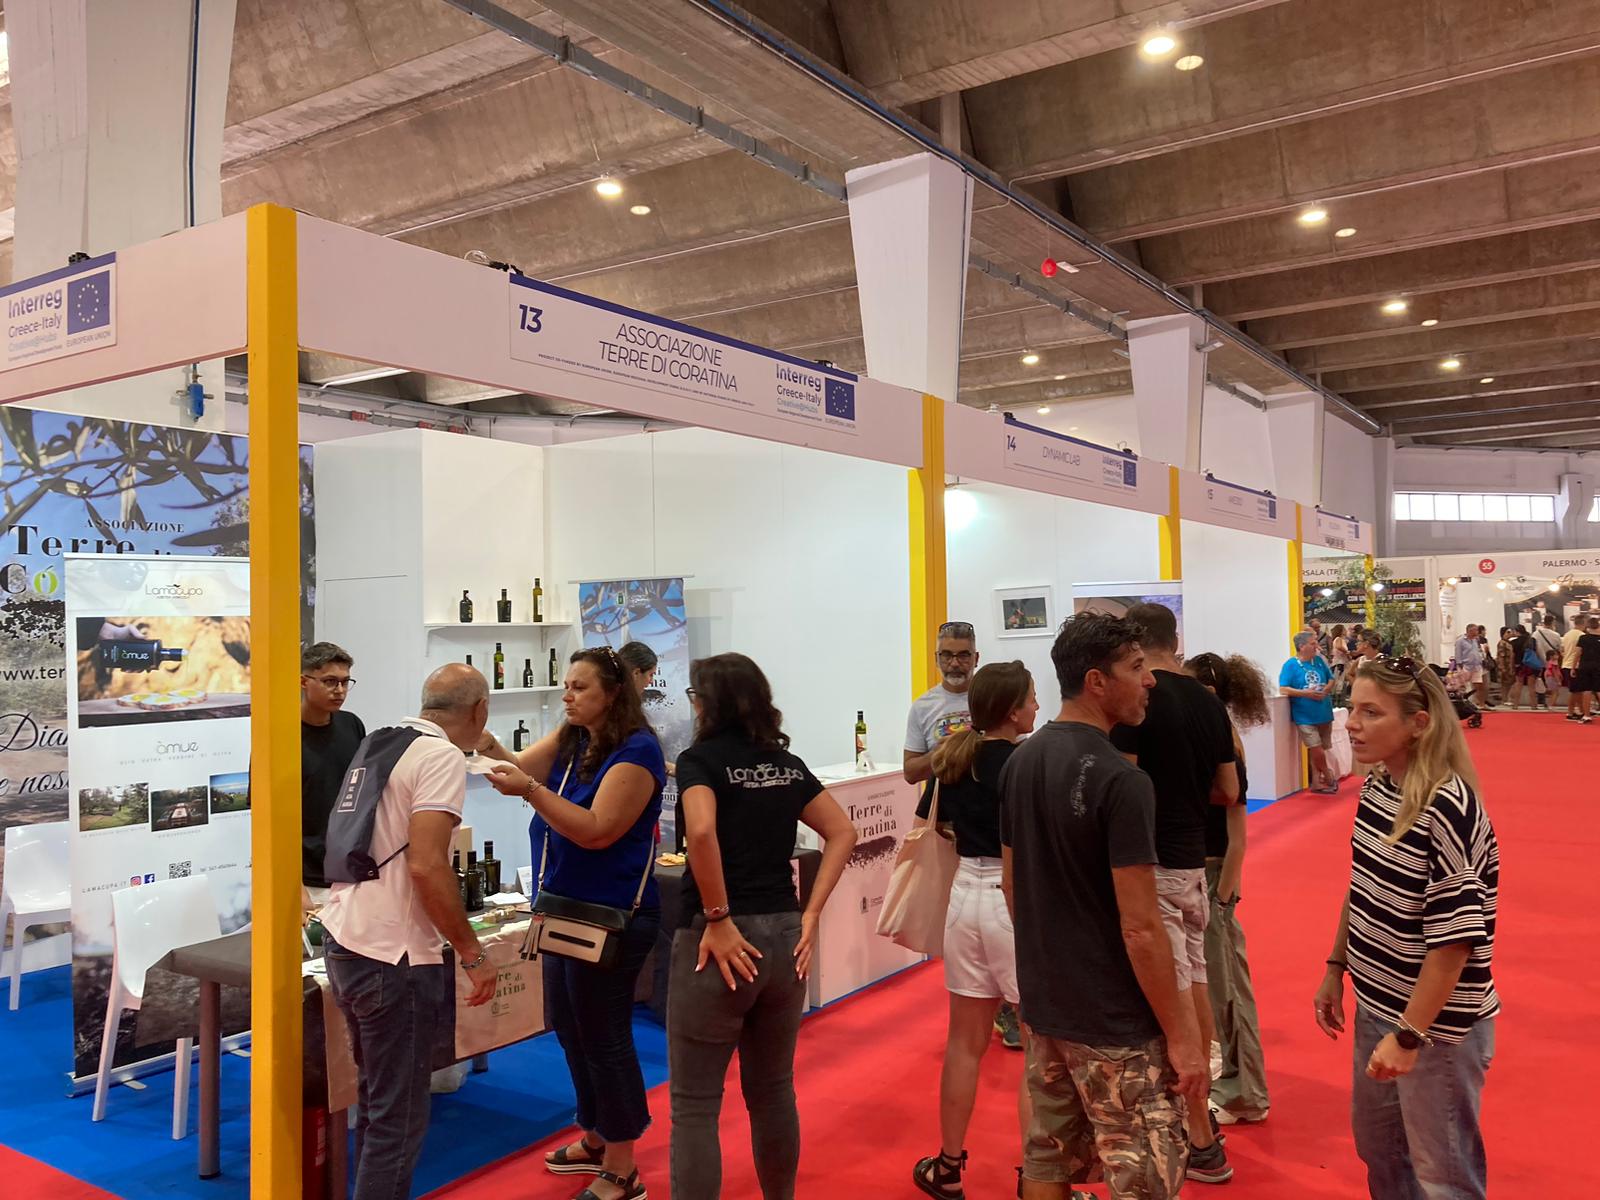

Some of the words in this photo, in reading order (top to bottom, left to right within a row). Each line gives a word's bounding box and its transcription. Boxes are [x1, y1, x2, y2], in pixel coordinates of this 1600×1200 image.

[8, 289, 63, 319] Interreg
[8, 313, 62, 338] Greece-Italy
[519, 304, 543, 333] 13
[616, 323, 723, 367] ASSOCIAZIONE
[599, 340, 650, 371] TERRE
[651, 355, 667, 375] DI
[669, 360, 738, 392] CORATINA
[776, 363, 822, 392] Interreg
[777, 385, 822, 407] Greece-Italy
[1007, 435, 1016, 451] 14
[85, 518, 185, 533] ASSOCIAZIONE
[8, 525, 135, 556] Terre
[1542, 559, 1587, 567] PALERMO
[0, 666, 66, 681] ww.ter
[18, 771, 69, 795] nos
[848, 803, 882, 821] Terre
[884, 805, 893, 818] di
[861, 819, 897, 838] ratina
